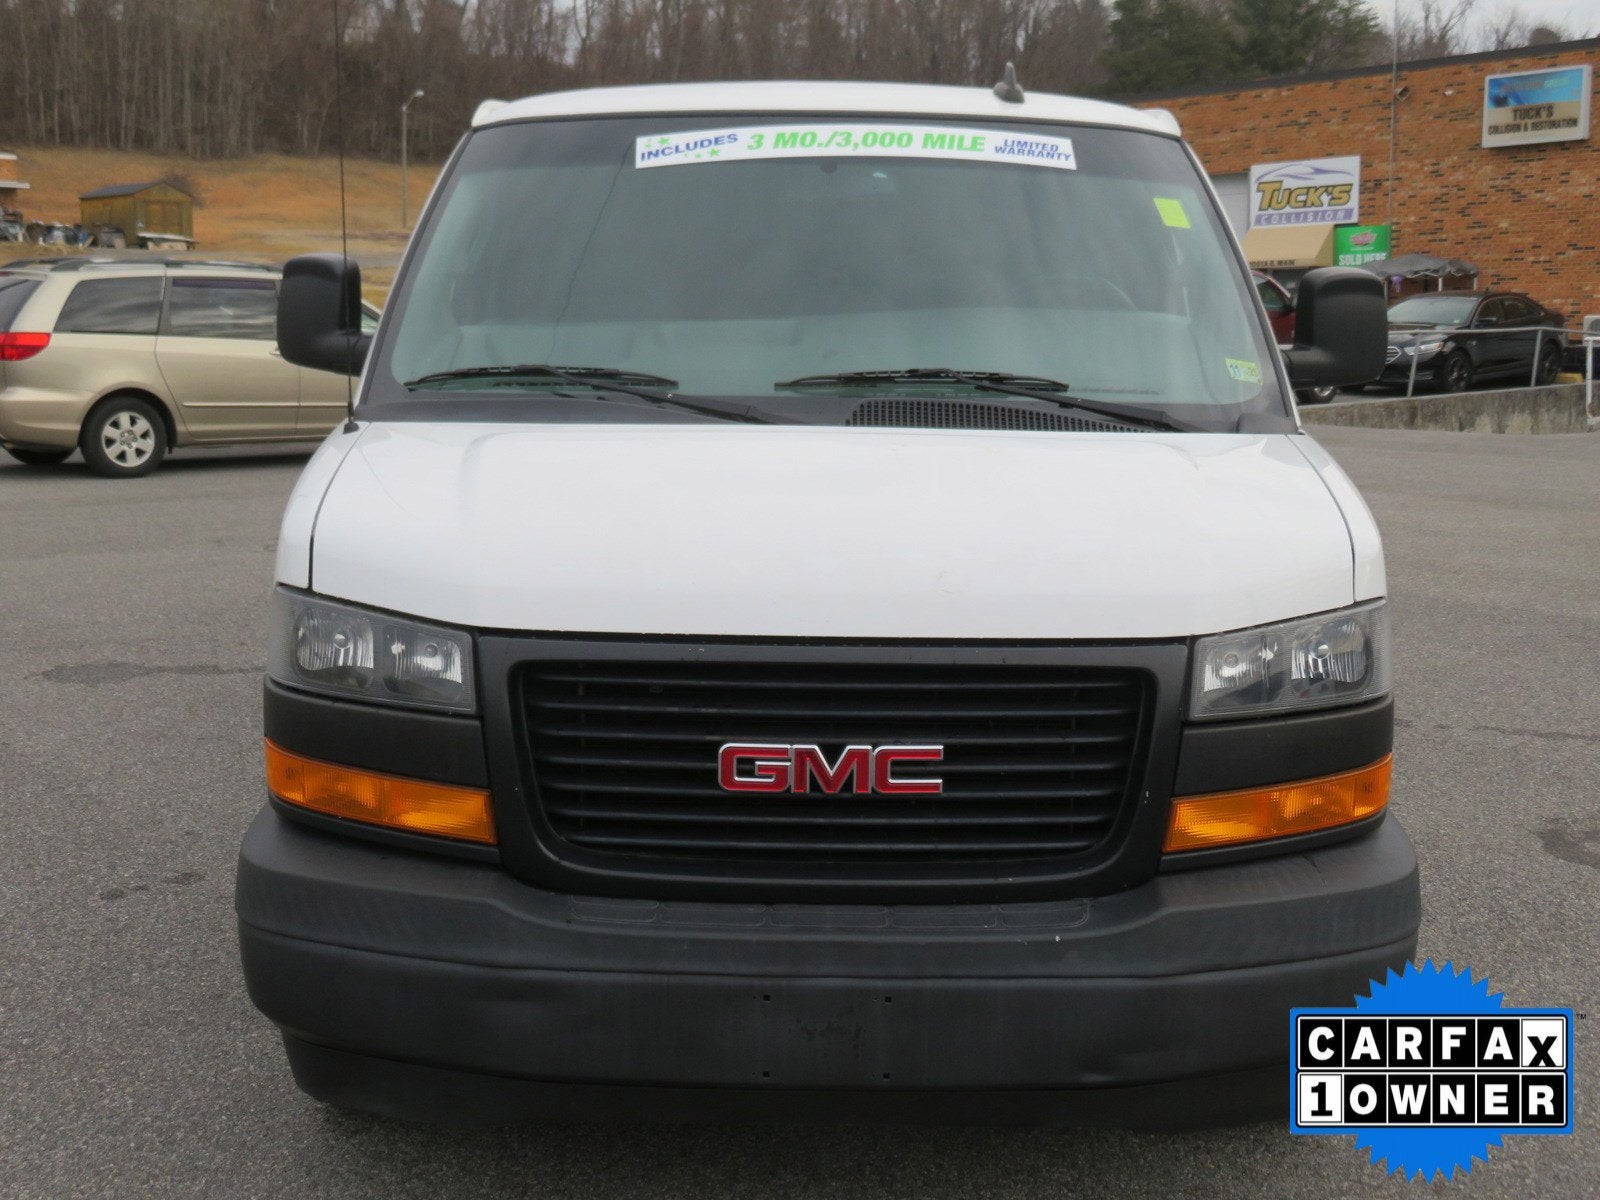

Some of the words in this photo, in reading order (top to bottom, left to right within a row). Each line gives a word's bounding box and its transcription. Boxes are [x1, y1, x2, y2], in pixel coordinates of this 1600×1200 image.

[1512, 103, 1554, 121] TUCK'S
[1488, 123, 1521, 135] COLLISION
[1531, 118, 1578, 132] RESTORATION
[640, 133, 739, 162] INCLUDES
[747, 133, 764, 150] 3
[773, 131, 913, 151] MO./3,000
[922, 132, 986, 152] MILE
[994, 145, 1073, 162] WARRANTY
[1003, 138, 1059, 153] LIMITED
[1256, 180, 1353, 212] TUCK'S
[1261, 210, 1345, 225] COLLISION
[1338, 254, 1361, 266] SOLD
[718, 743, 944, 793] GMC
